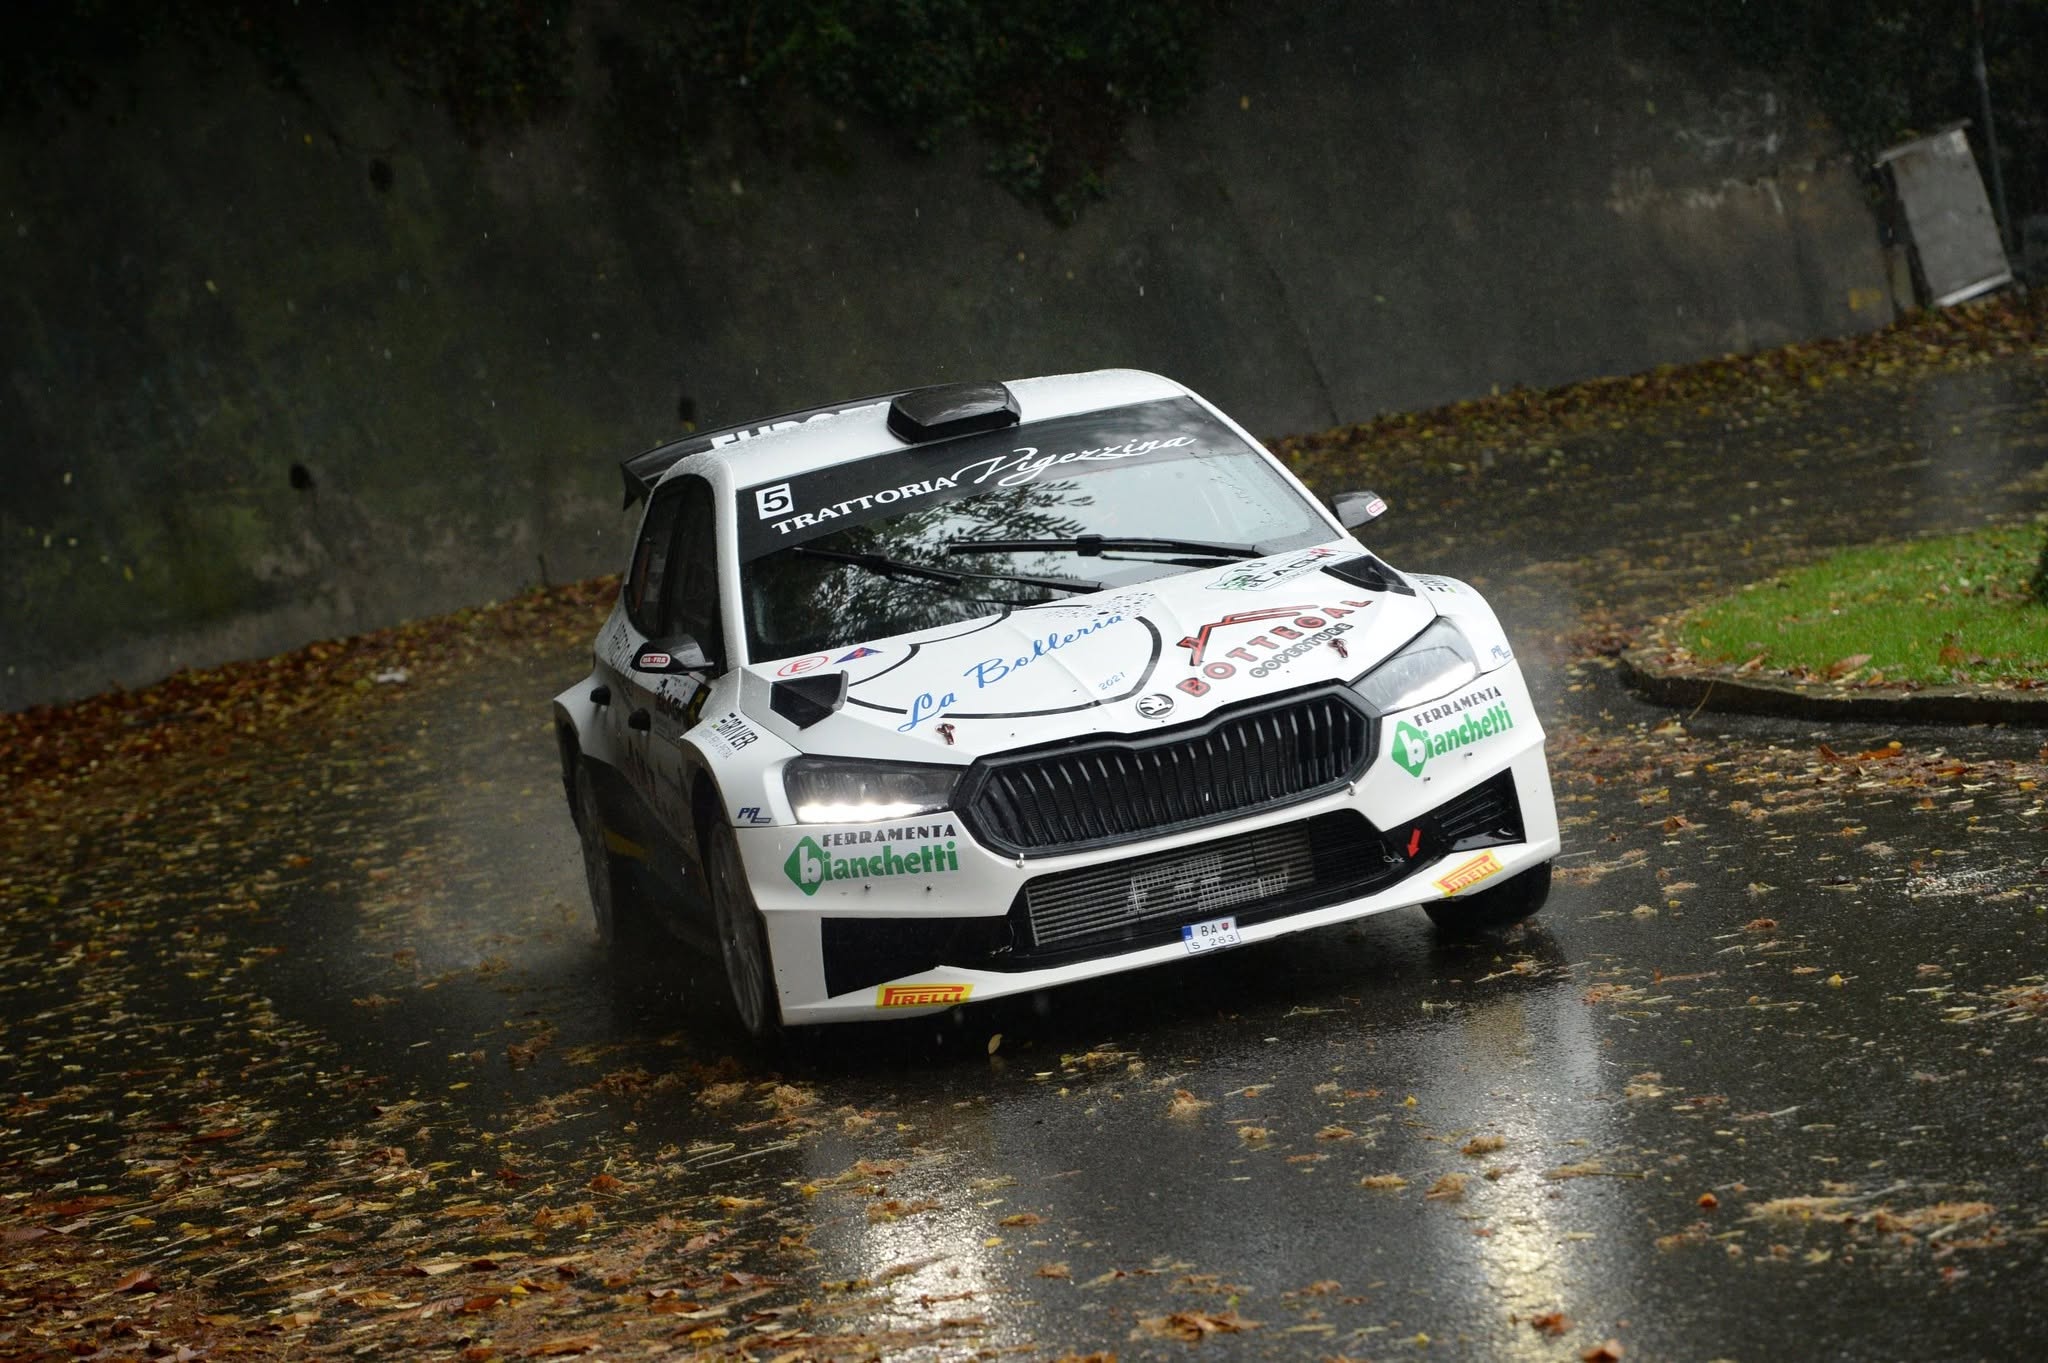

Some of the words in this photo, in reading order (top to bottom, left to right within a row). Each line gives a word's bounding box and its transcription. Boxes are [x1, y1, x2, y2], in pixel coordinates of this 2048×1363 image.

[762, 488, 790, 514] 5
[772, 476, 957, 535] TRATTORIA
[951, 436, 1198, 488] Vigezzina
[1176, 600, 1373, 697] BOTTEGAL
[1249, 623, 1354, 678] COPERTURE
[897, 691, 958, 732] La
[963, 615, 1125, 689] Bolleria
[1099, 671, 1127, 690] 2021
[1413, 686, 1502, 727] FERRAMENTA
[1398, 700, 1514, 767] bianchetti
[823, 824, 957, 847] FERRAMENTA
[800, 840, 959, 884] bianchetti
[1439, 855, 1499, 894] PIRELLI
[1192, 941, 1200, 950] S
[1209, 934, 1235, 946] 283
[1201, 923, 1218, 936] BA
[883, 986, 965, 1007] PIRELLI
